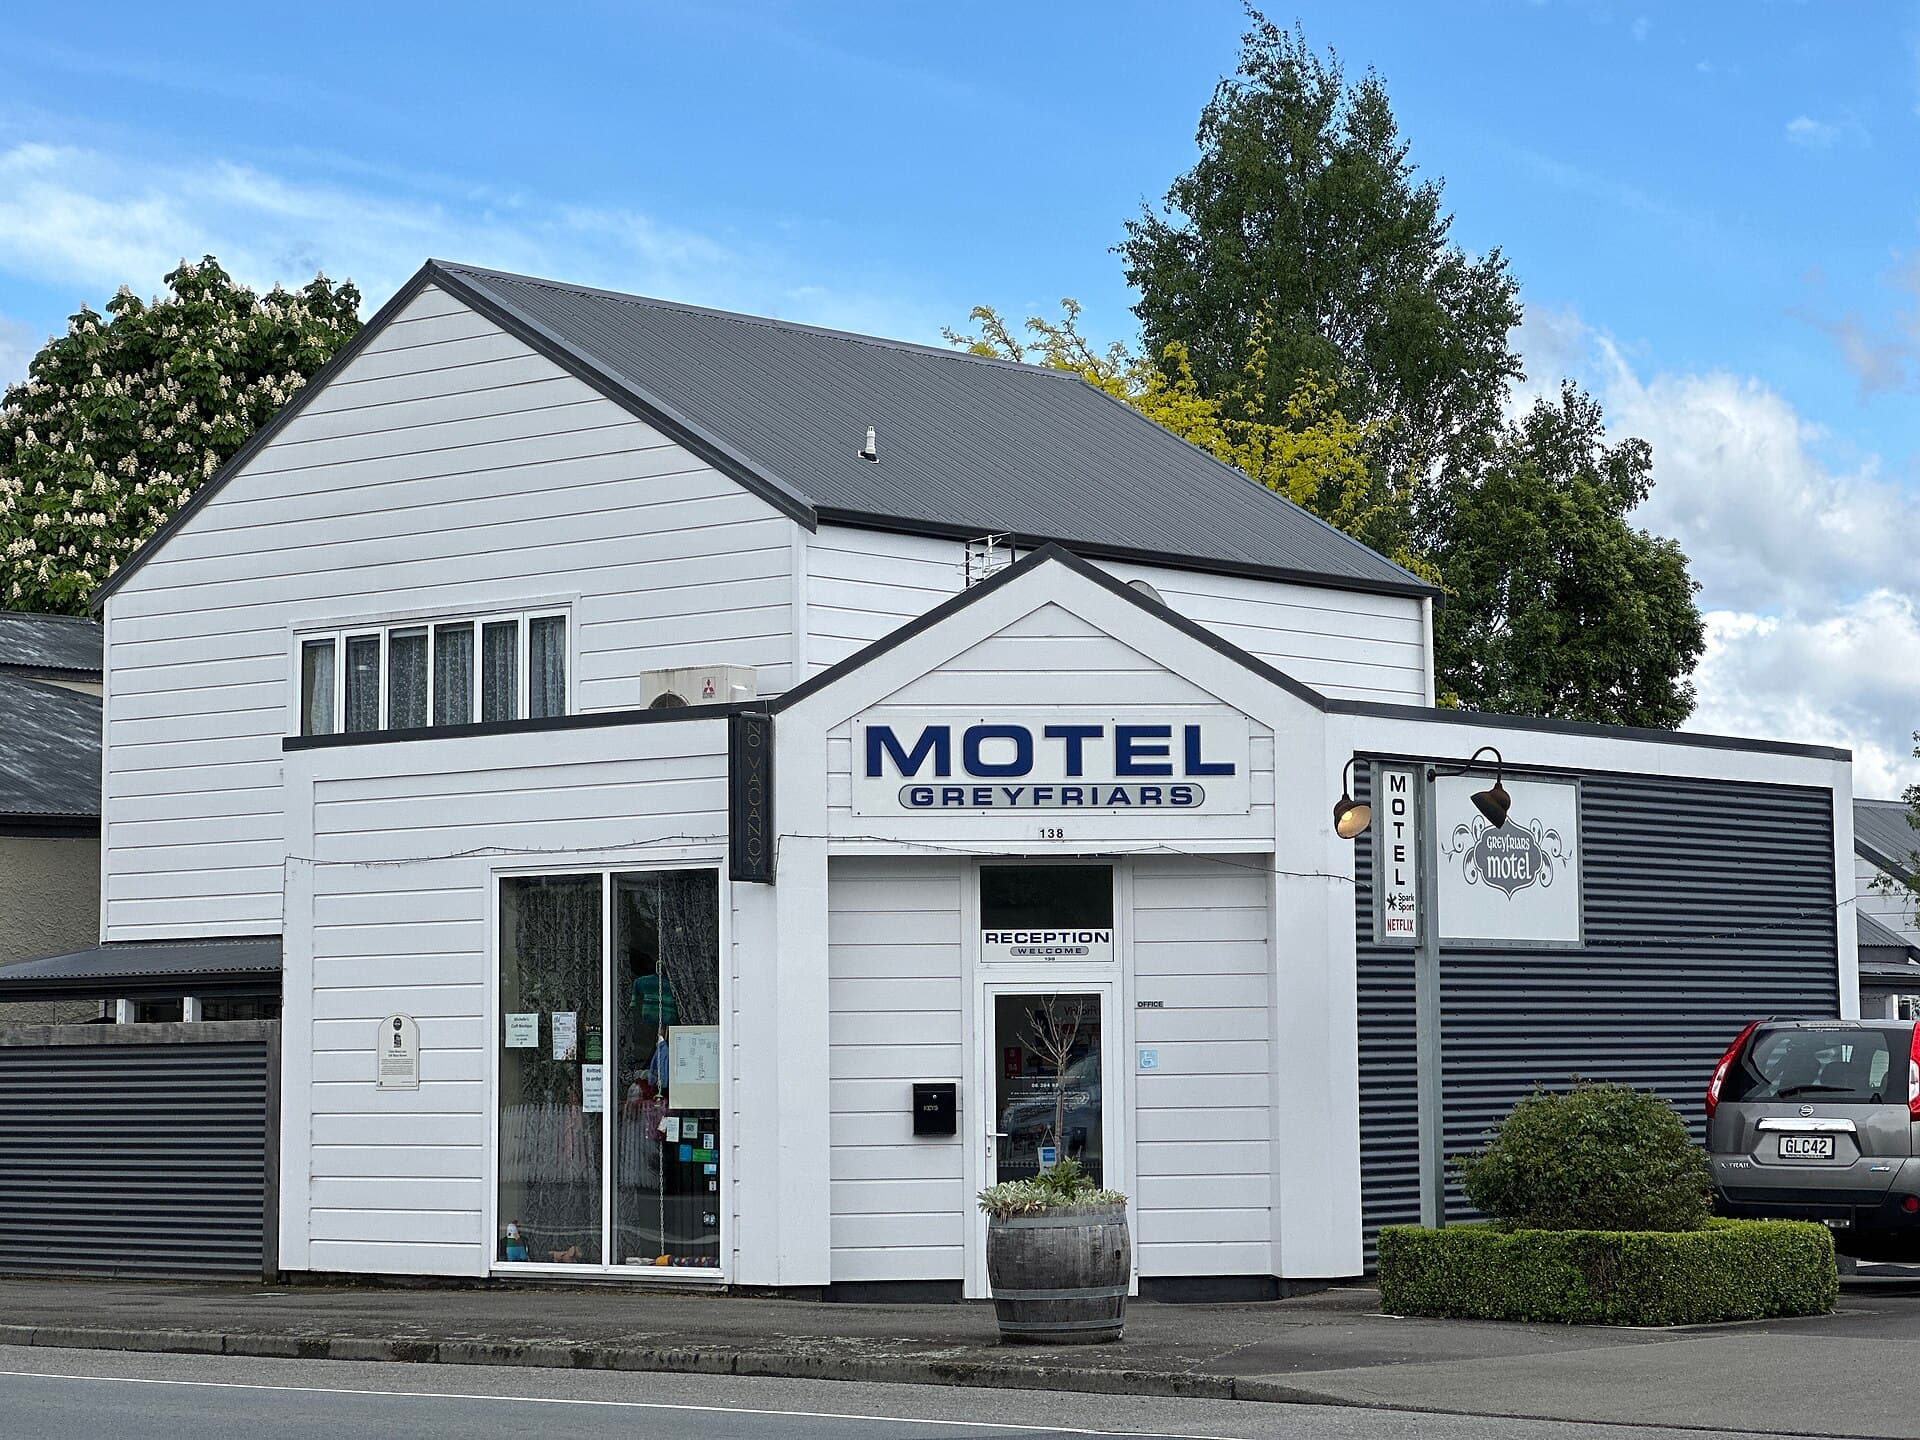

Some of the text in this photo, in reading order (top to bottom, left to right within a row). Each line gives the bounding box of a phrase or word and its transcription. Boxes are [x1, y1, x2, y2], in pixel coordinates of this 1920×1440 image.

[865, 724, 1236, 777] MOTEL
[911, 786, 1193, 806] GREYFRIARS
[1039, 828, 1065, 840] 138
[1390, 774, 1406, 886] MOTEL
[1398, 892, 1414, 903] Spark
[1398, 902, 1415, 913] Sport
[1387, 918, 1414, 932] NETFLIX
[985, 932, 1110, 944] RECEPTION
[1785, 1139, 1827, 1154] GLC42
